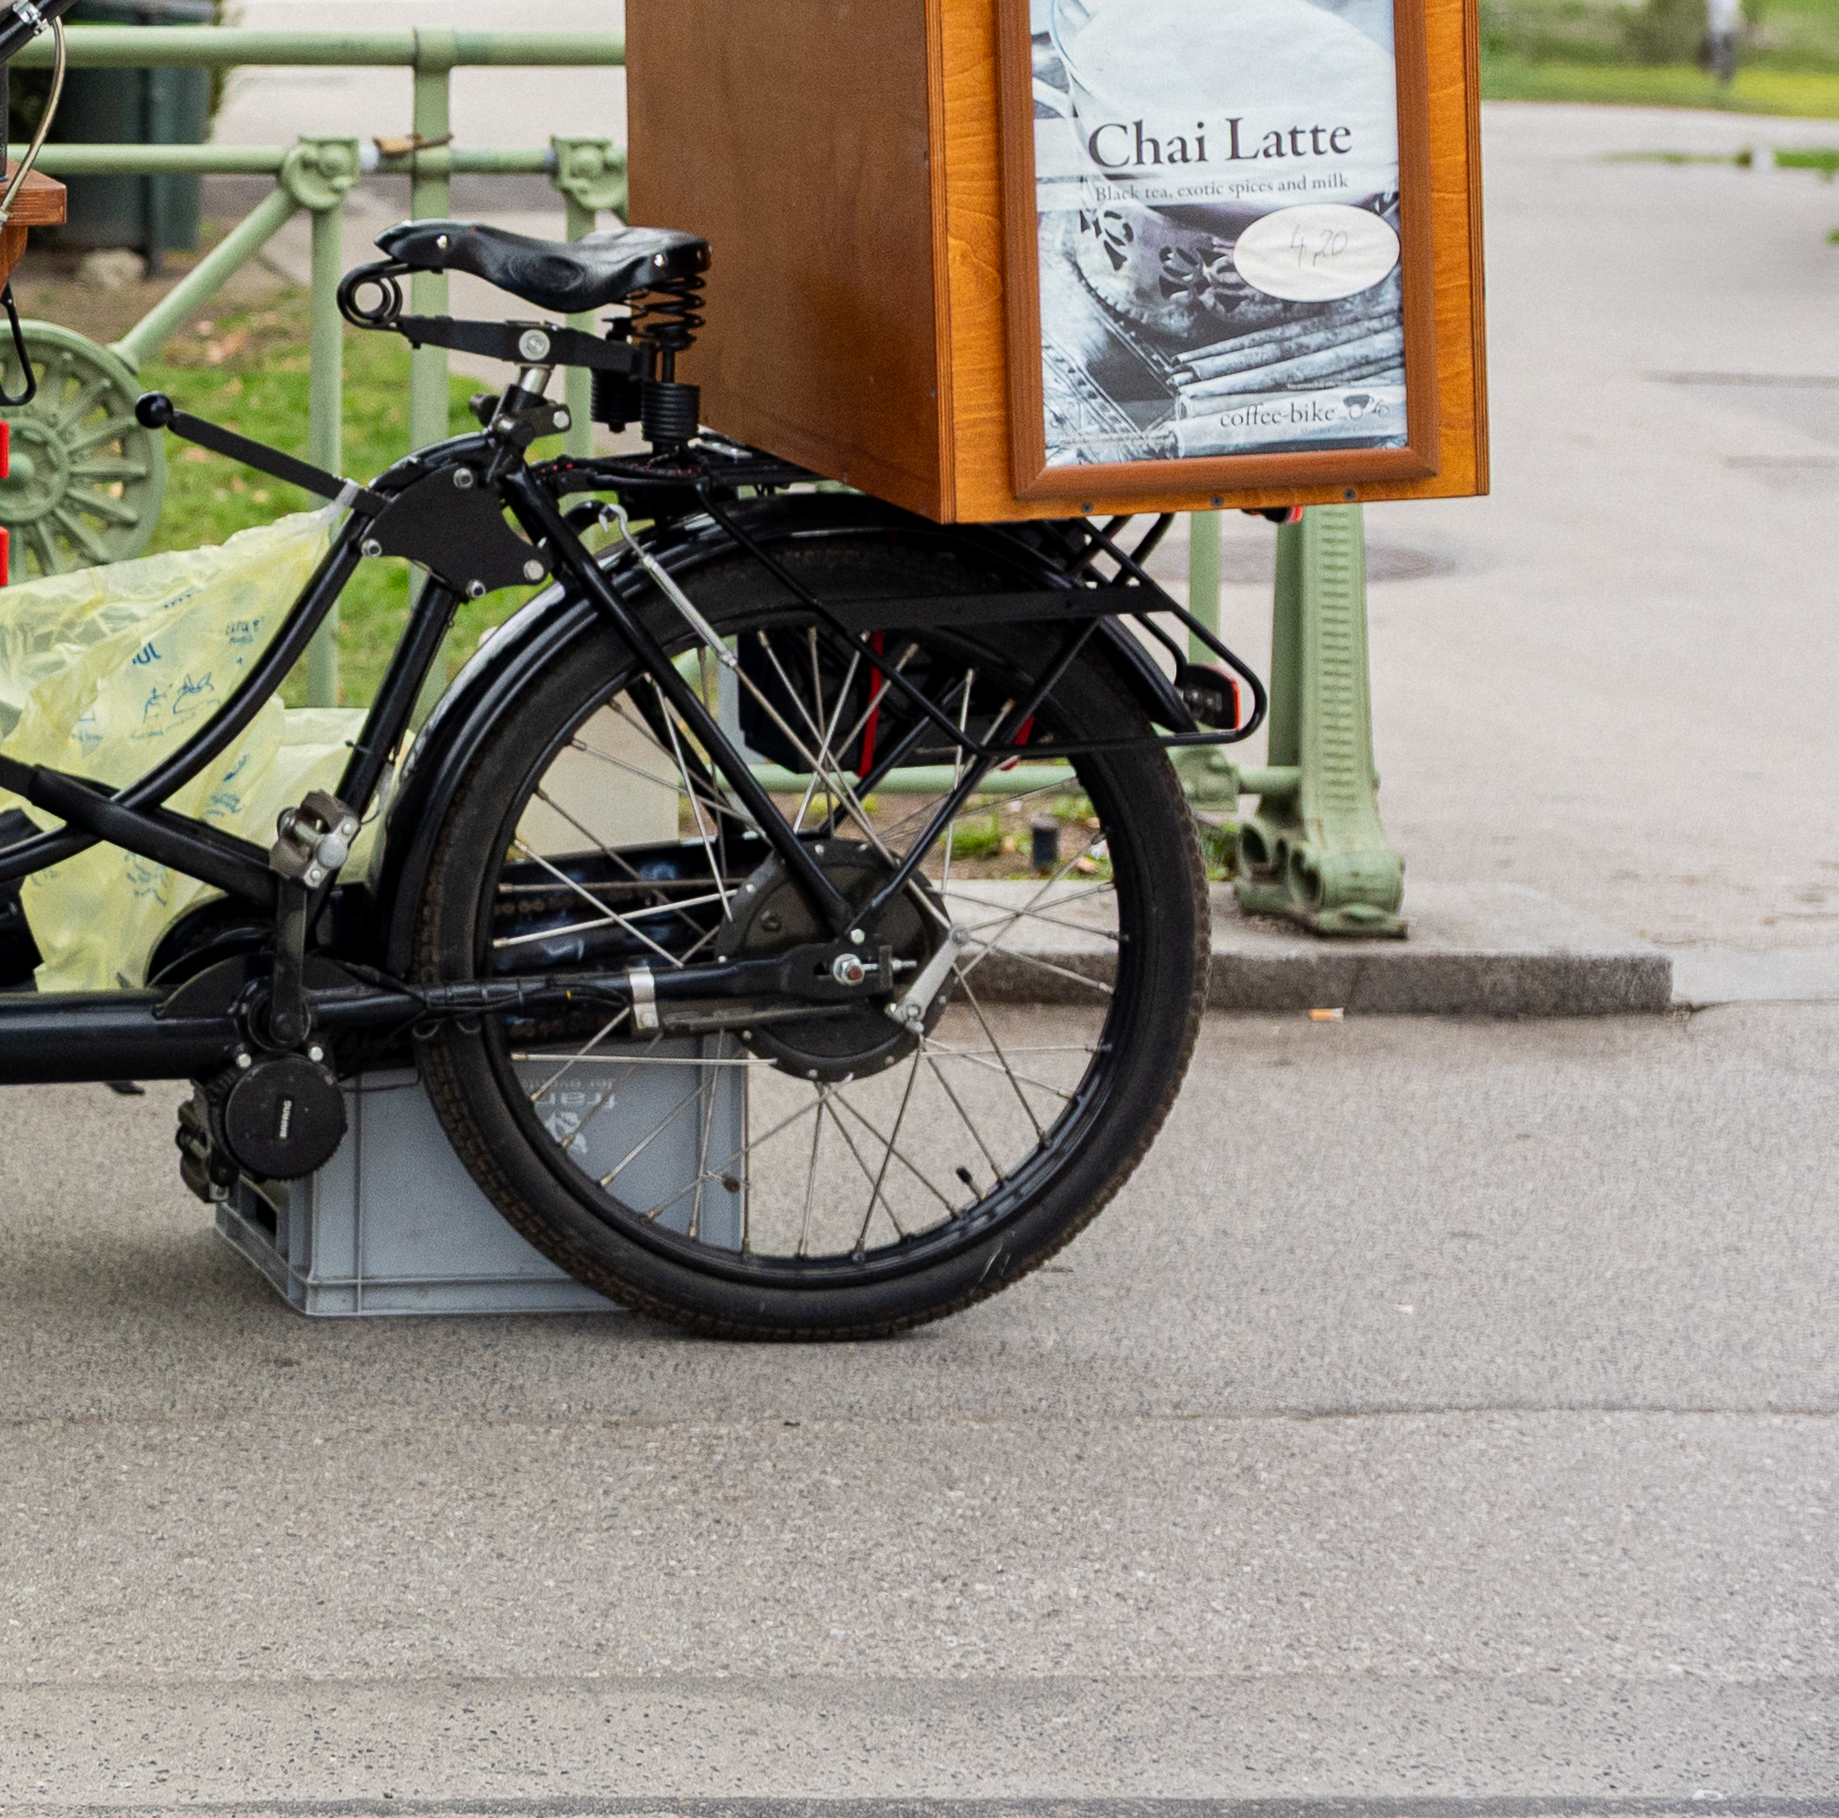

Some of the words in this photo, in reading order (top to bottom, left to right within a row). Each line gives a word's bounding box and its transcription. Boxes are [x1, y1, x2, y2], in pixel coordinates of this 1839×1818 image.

[1088, 118, 1209, 169] Chai
[1225, 117, 1352, 160] Latte
[1096, 185, 1140, 201] Black
[1145, 187, 1173, 199] tea,
[1178, 183, 1223, 198] exotic
[1228, 181, 1273, 199] spices
[1278, 177, 1307, 192] and
[1312, 173, 1348, 189] milk
[1220, 402, 1334, 428] coffee-bike
